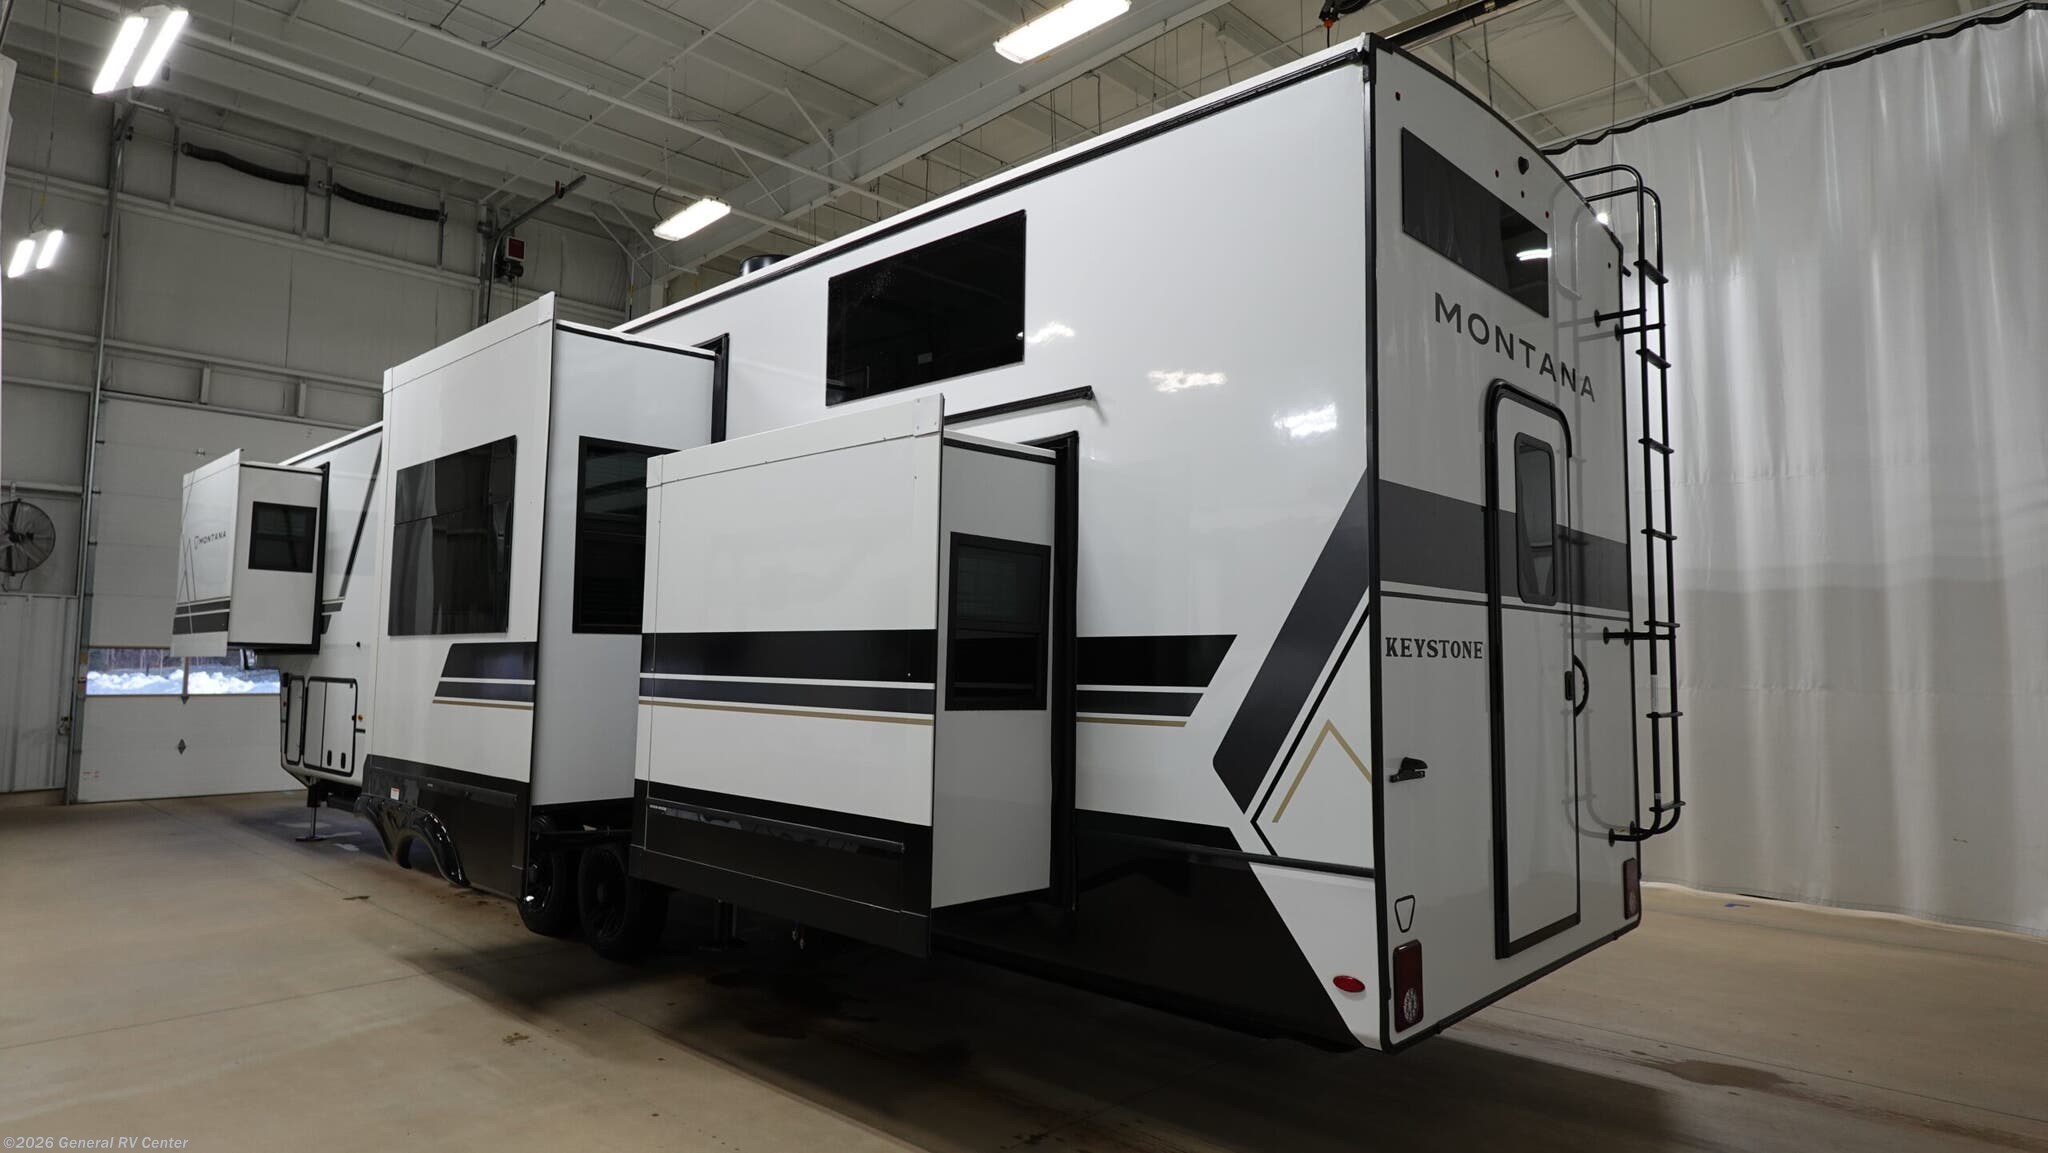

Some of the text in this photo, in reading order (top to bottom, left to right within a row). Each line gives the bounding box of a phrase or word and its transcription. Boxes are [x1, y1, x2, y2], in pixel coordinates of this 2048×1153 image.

[1435, 292, 1595, 402] MONTANA
[199, 531, 226, 544] MONTANA
[1385, 637, 1483, 660] KEYSTONE
